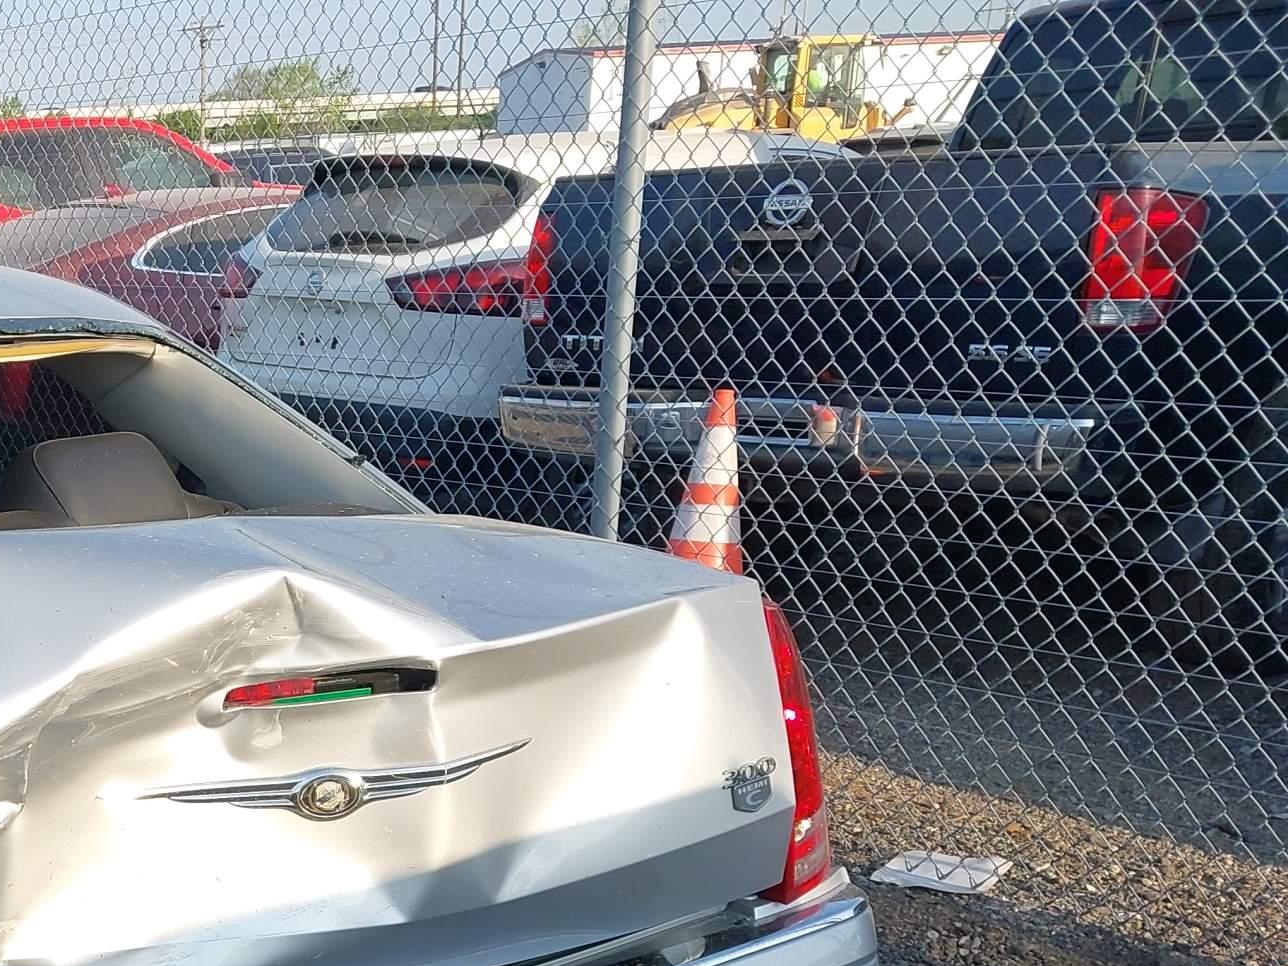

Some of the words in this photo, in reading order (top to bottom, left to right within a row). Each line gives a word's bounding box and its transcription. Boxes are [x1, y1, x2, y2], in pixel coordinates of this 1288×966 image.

[767, 198, 809, 209] NISSAN
[722, 756, 777, 790] 300
[737, 779, 768, 795] HEMI
[746, 789, 763, 806] C
